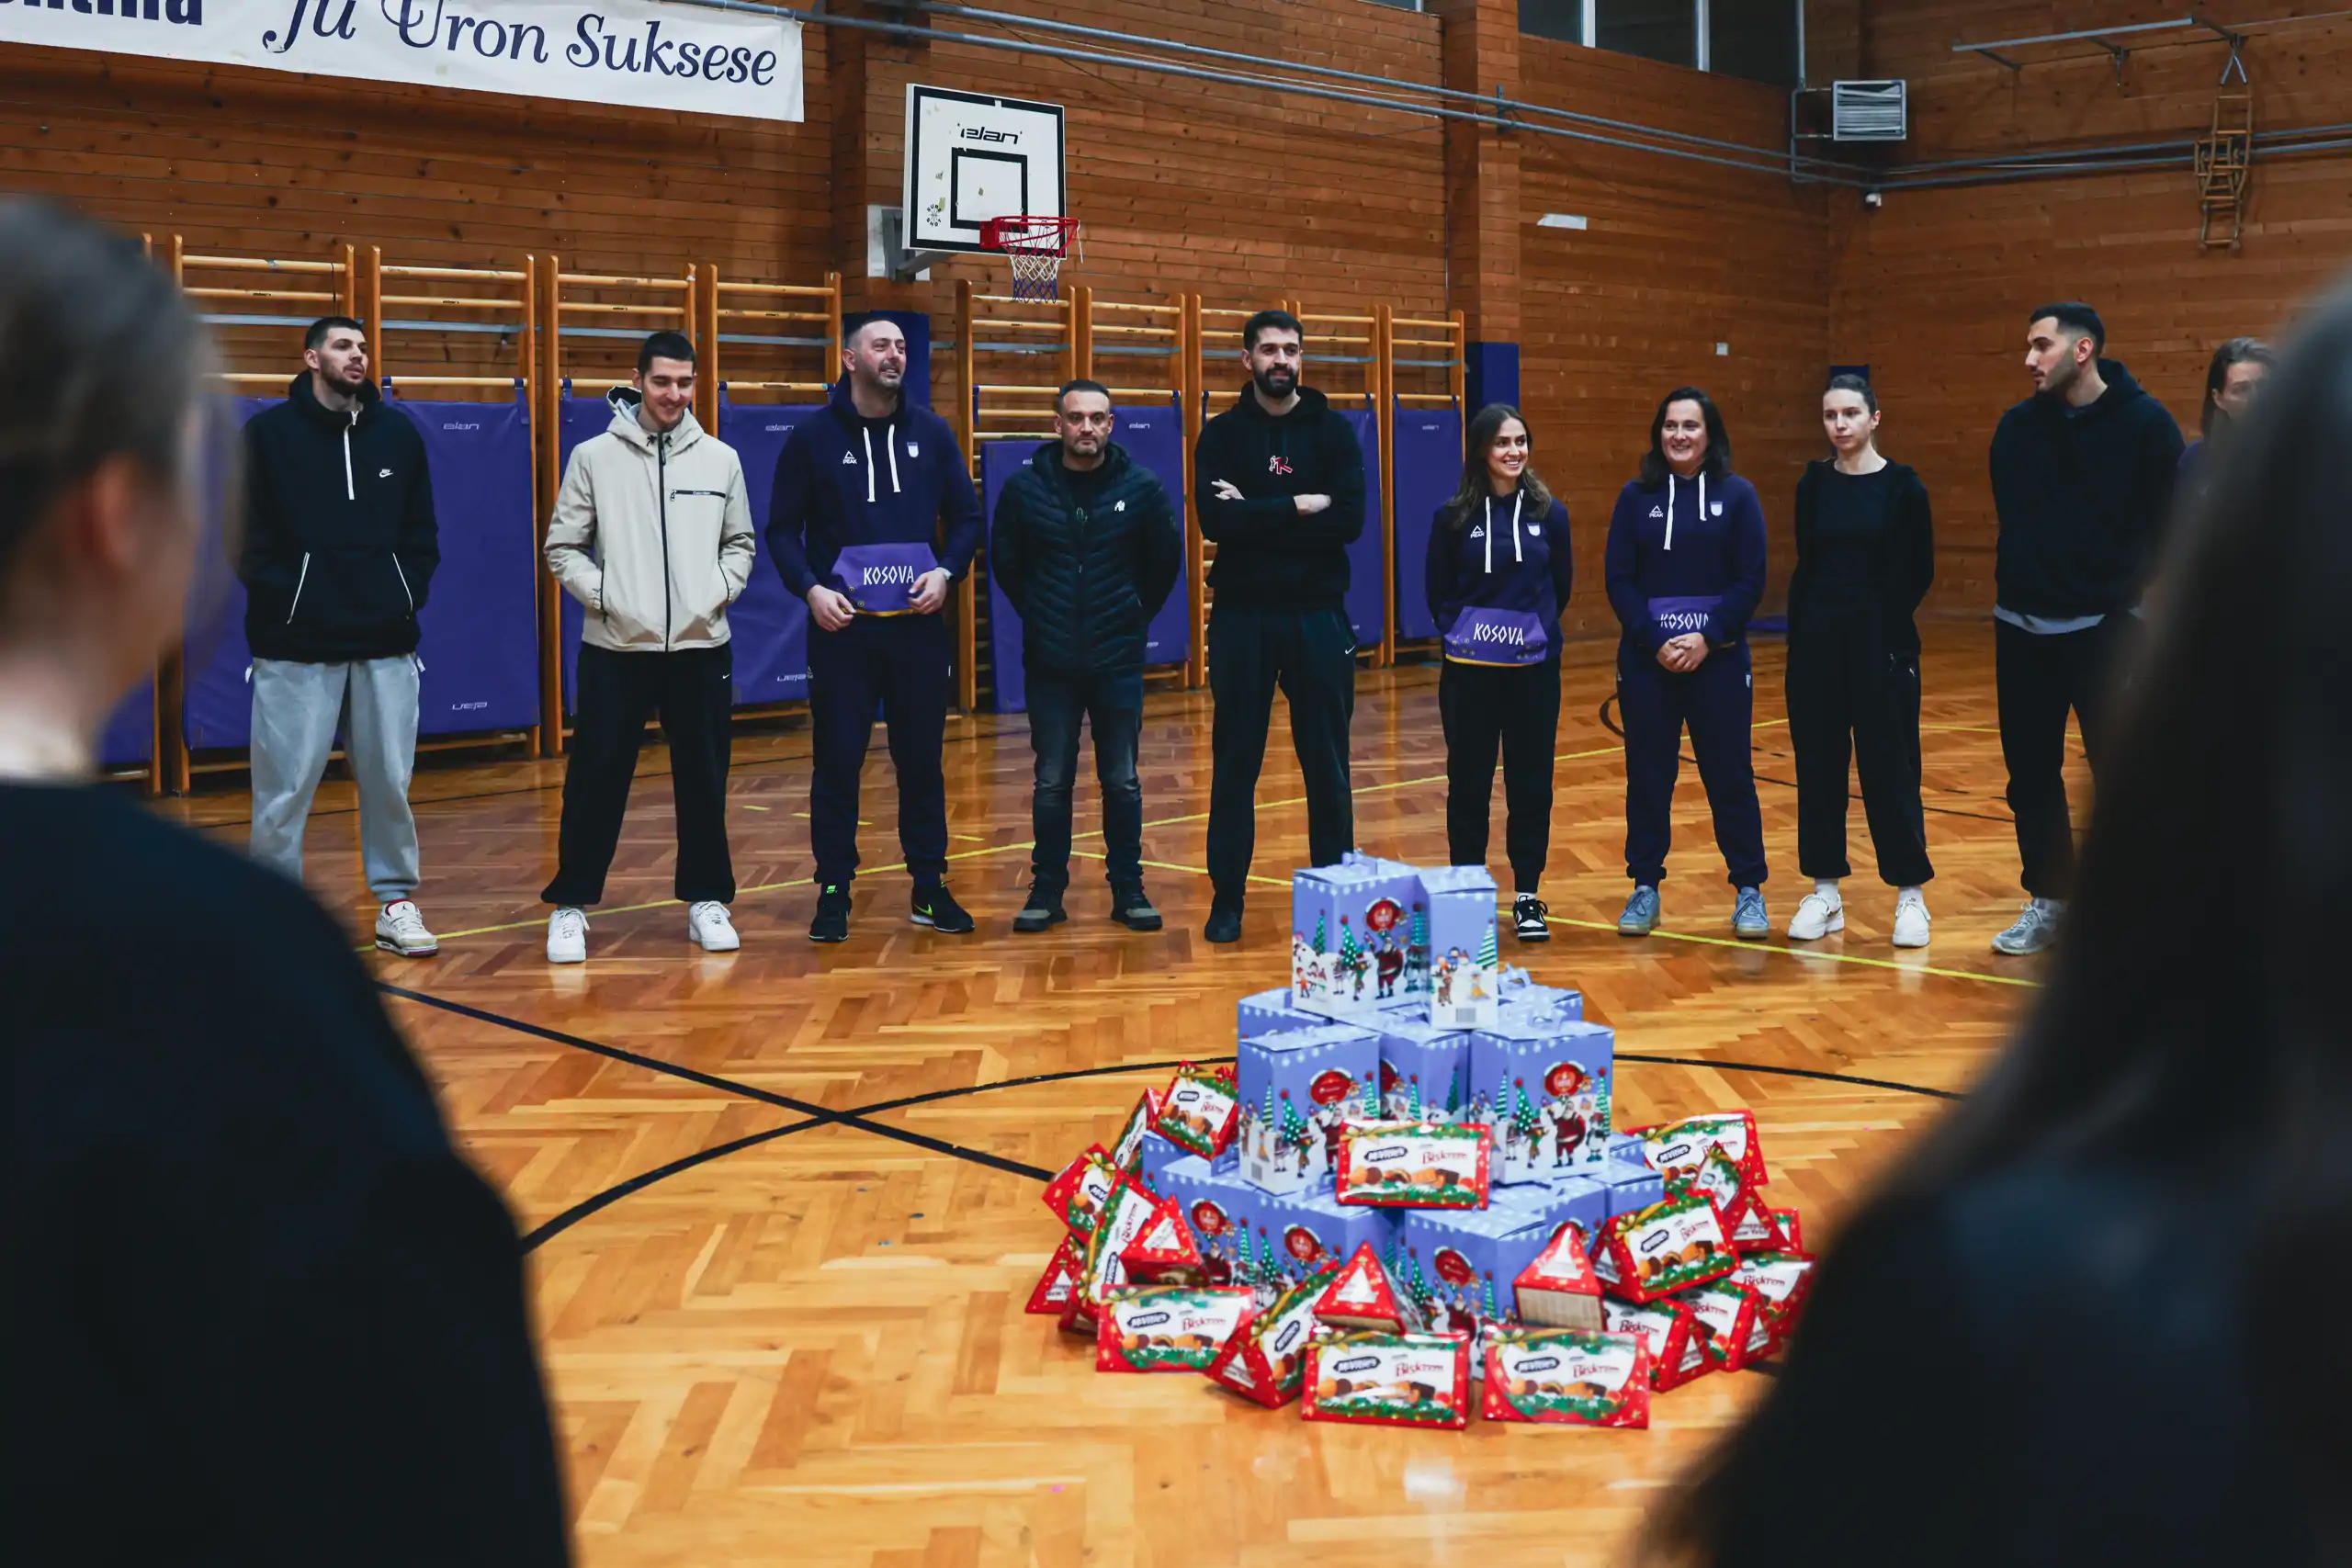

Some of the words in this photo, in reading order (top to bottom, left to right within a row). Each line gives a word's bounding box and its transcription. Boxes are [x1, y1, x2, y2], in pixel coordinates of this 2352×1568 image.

[380, 0, 548, 63] Uron
[565, 13, 777, 85] Suksese
[960, 126, 1019, 144] elan
[864, 565, 914, 585] KOSOVA
[1473, 623, 1524, 646] KOSOVA
